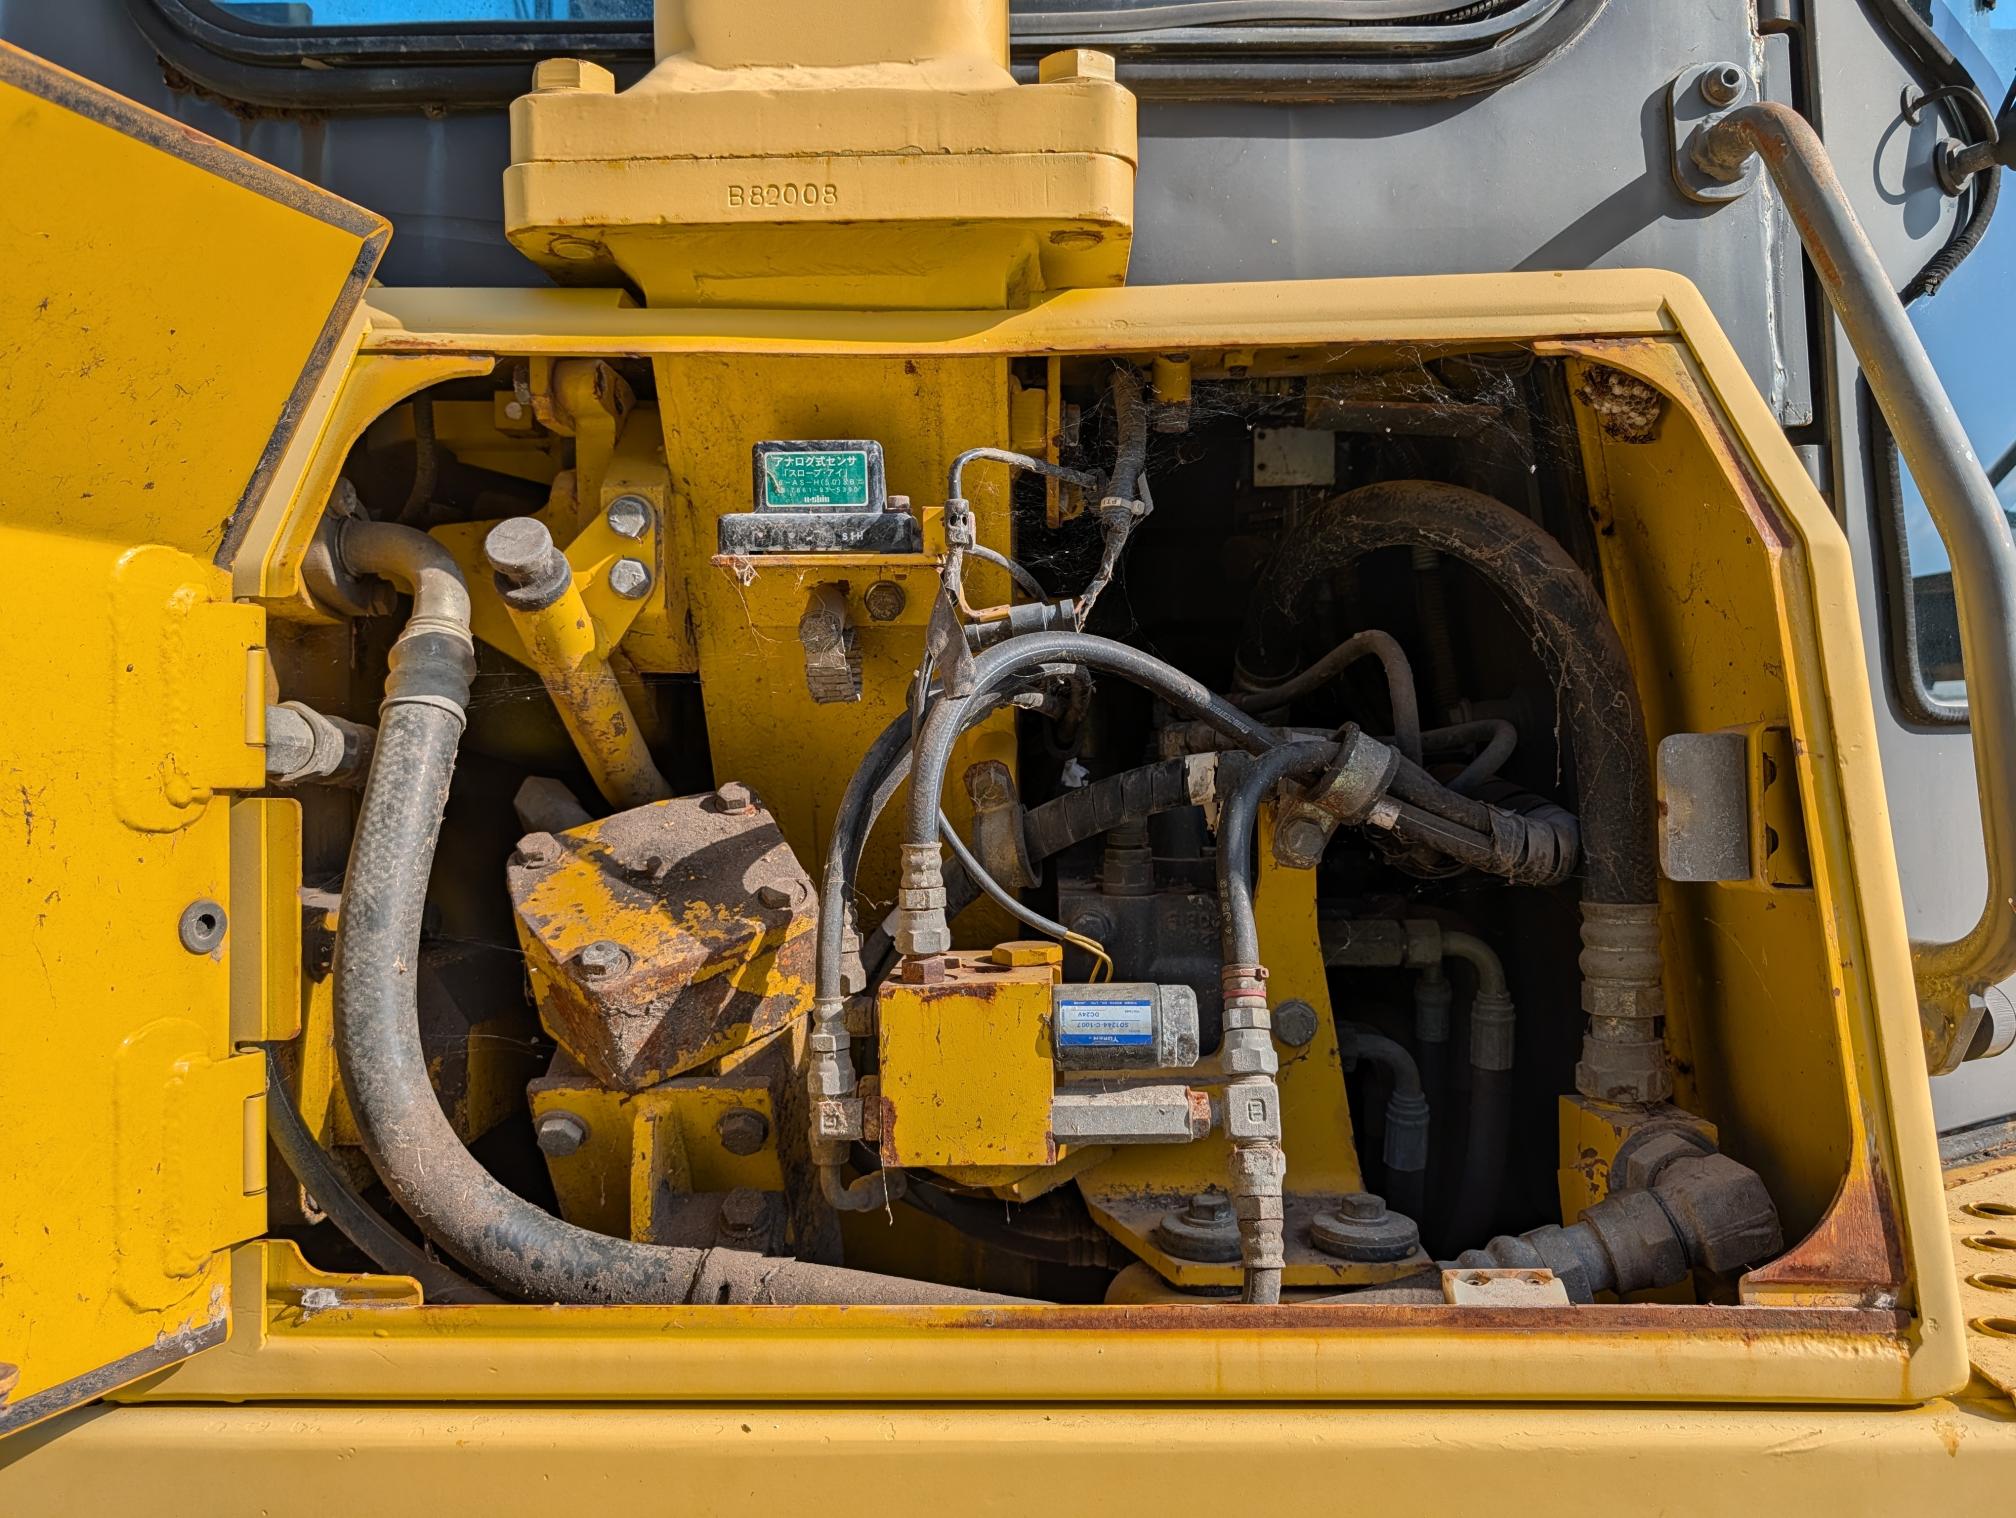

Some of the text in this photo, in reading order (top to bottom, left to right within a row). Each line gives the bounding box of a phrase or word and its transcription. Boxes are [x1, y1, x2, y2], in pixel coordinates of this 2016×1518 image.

[727, 182, 838, 208] B82008
[774, 455, 857, 467] アナログ式センサ
